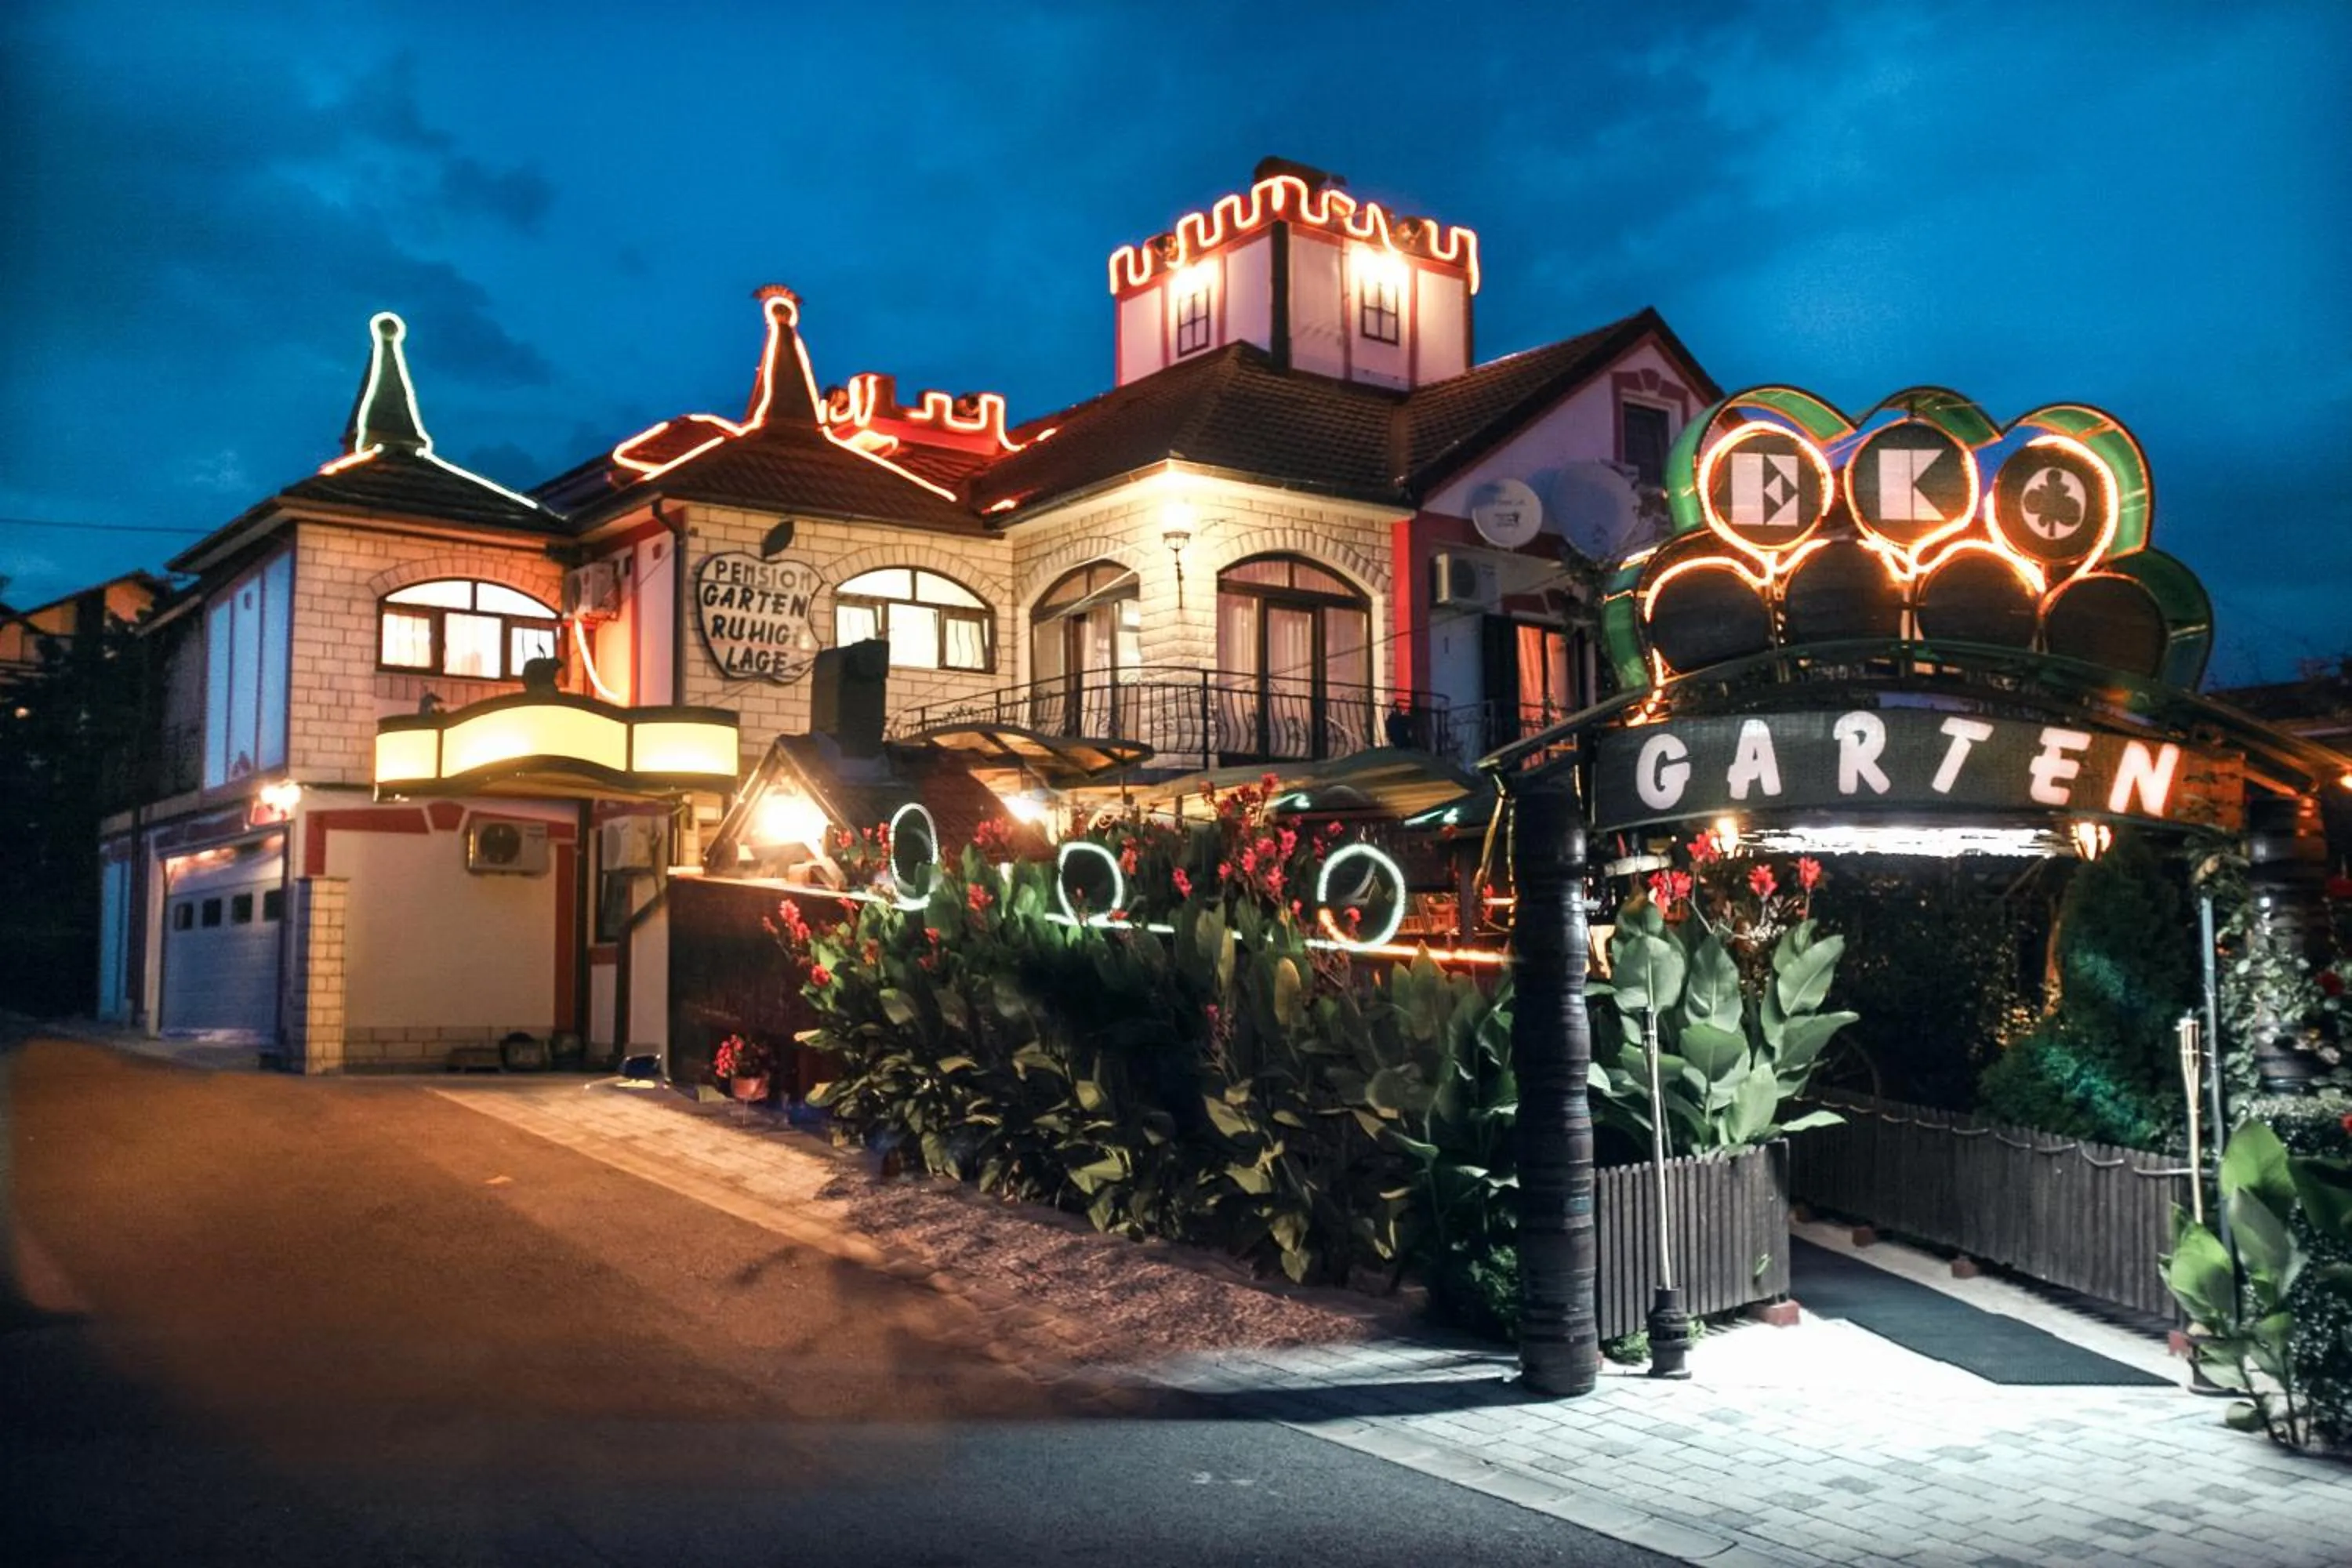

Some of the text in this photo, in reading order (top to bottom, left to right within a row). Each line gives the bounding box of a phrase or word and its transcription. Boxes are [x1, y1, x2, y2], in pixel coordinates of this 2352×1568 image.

[714, 560, 812, 591] PENSION
[702, 585, 808, 618] GARTEN
[726, 647, 789, 674] LAGE
[1635, 710, 2180, 817] GARTEN
